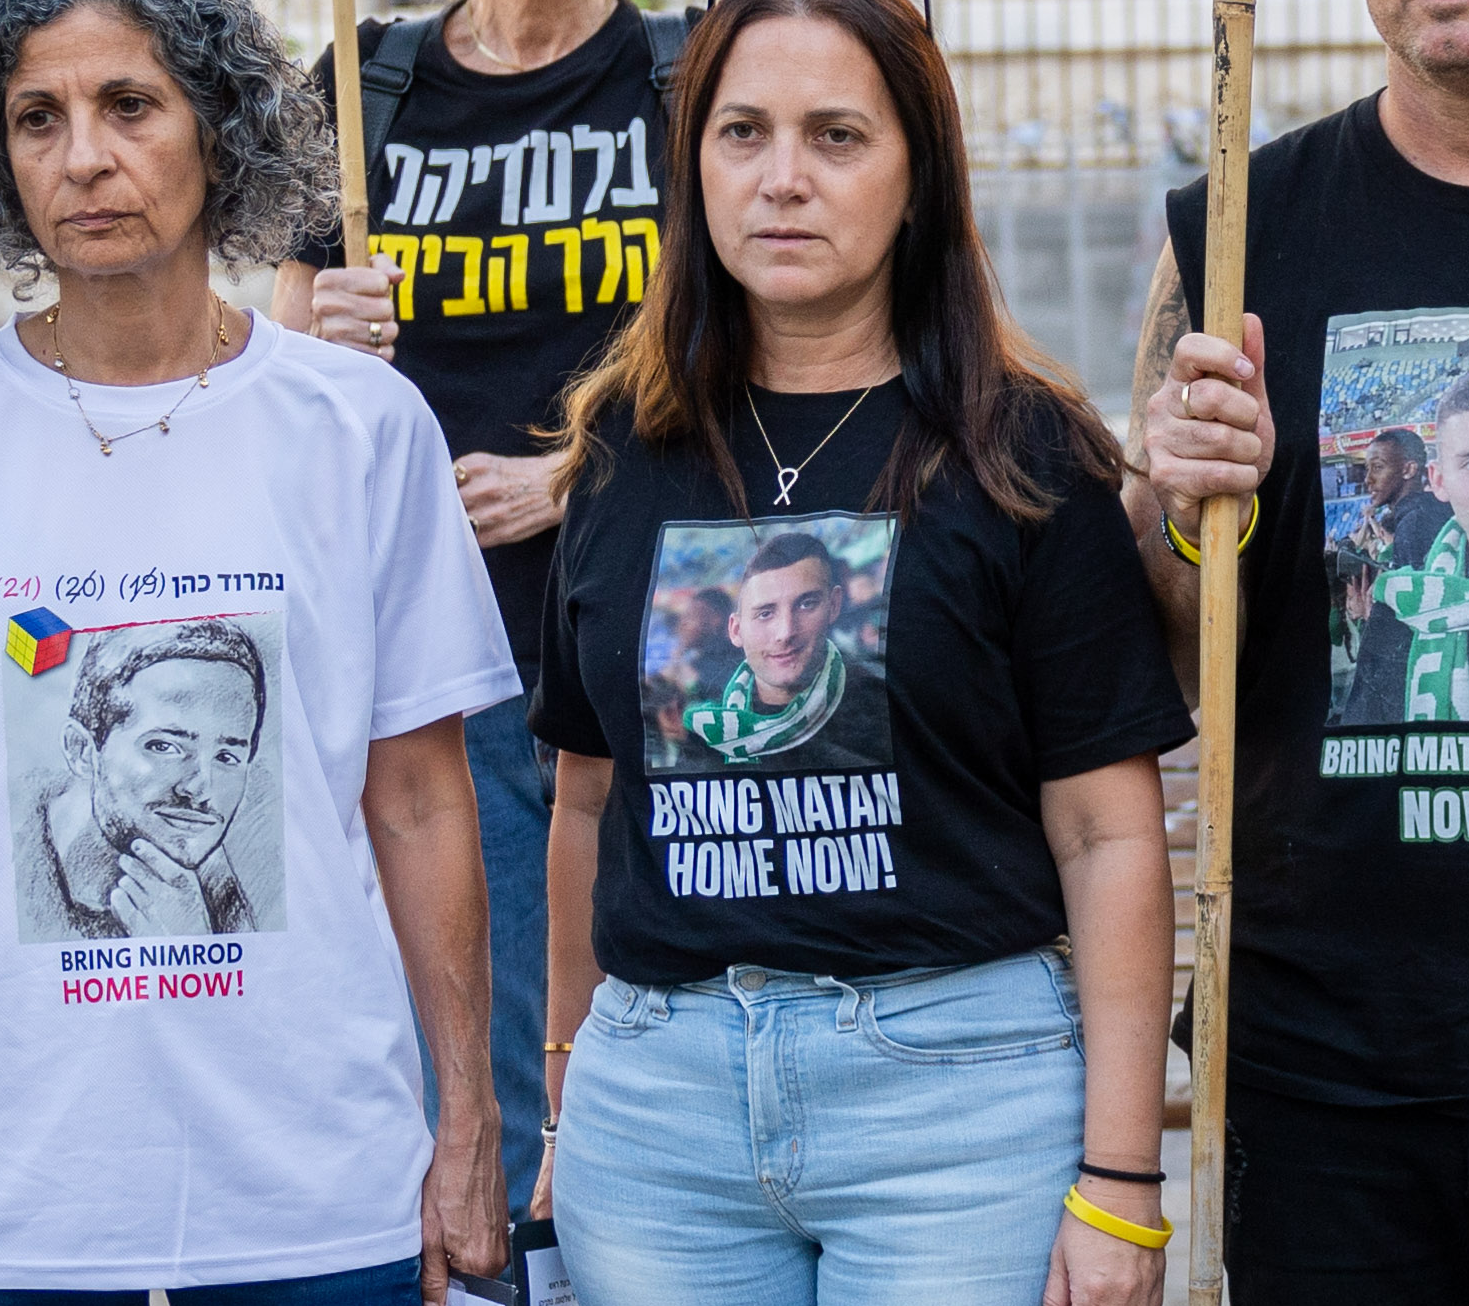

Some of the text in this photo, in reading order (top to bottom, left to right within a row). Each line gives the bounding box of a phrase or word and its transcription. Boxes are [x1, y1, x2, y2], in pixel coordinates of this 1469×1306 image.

[544, 217, 661, 313] הלך
[172, 574, 211, 596] כהן
[218, 571, 285, 592] נמרוד
[1324, 737, 1399, 775] BRING
[649, 772, 902, 837] BRING MATAN
[667, 832, 897, 899] HOME NOW!
[61, 942, 243, 972] BRING NIMROD
[63, 970, 245, 1005] HOME NOW!
